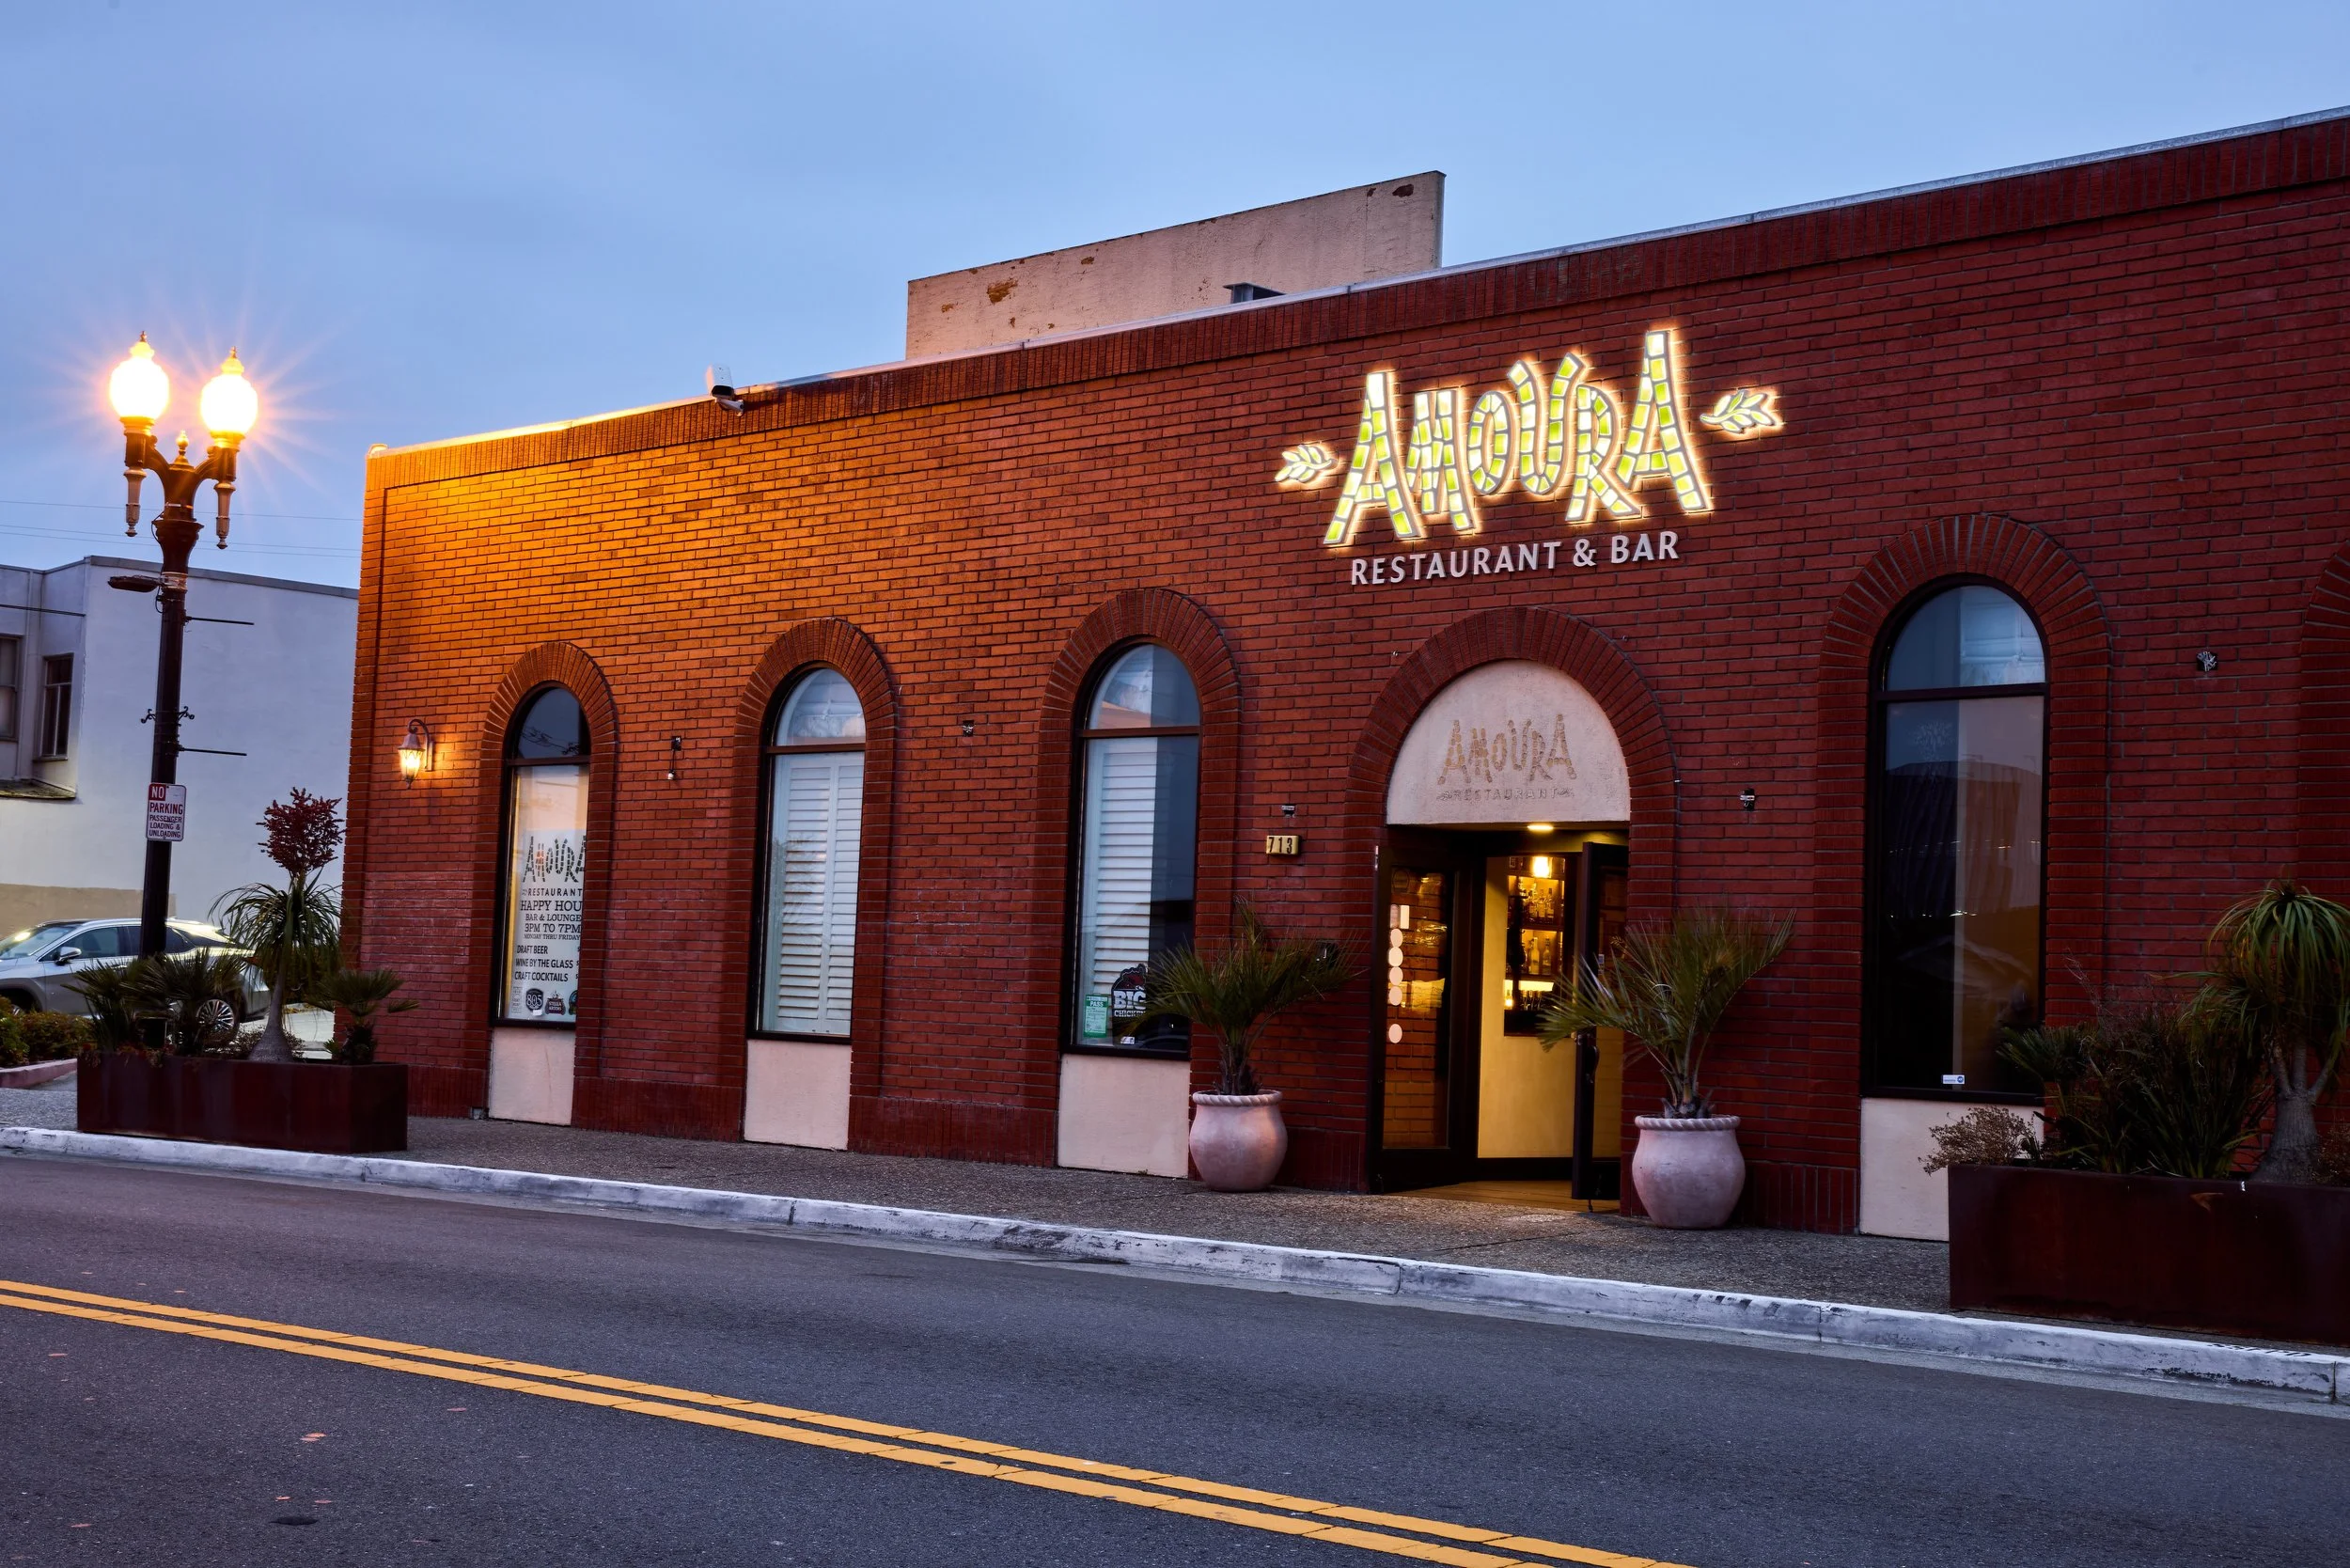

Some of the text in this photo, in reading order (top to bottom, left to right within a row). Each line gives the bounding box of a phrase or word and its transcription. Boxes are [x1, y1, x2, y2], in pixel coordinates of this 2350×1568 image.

[1324, 330, 1712, 545] AMOURA
[1351, 530, 1679, 586] RESTAURANT & BAR
[1437, 713, 1577, 786] AMOURA
[151, 786, 164, 799] NO
[149, 802, 183, 815] PARKING
[149, 815, 182, 823] PASSENGER
[149, 829, 181, 838] UNLOADING
[1269, 837, 1292, 854] 713
[523, 836, 586, 883] AMOURA
[528, 888, 582, 897] RESTAURANT
[520, 901, 552, 911] HAPPY
[525, 923, 581, 933] 3PM TO 7PM
[517, 945, 548, 954] DRAFT BEER
[529, 959, 537, 967] BY
[538, 959, 550, 967] THE
[551, 960, 573, 968] GLASS
[514, 971, 531, 980] CRAFT
[531, 972, 569, 981] COCKTAILS
[526, 994, 542, 1006] 805
[1113, 991, 1146, 1010] BIG
